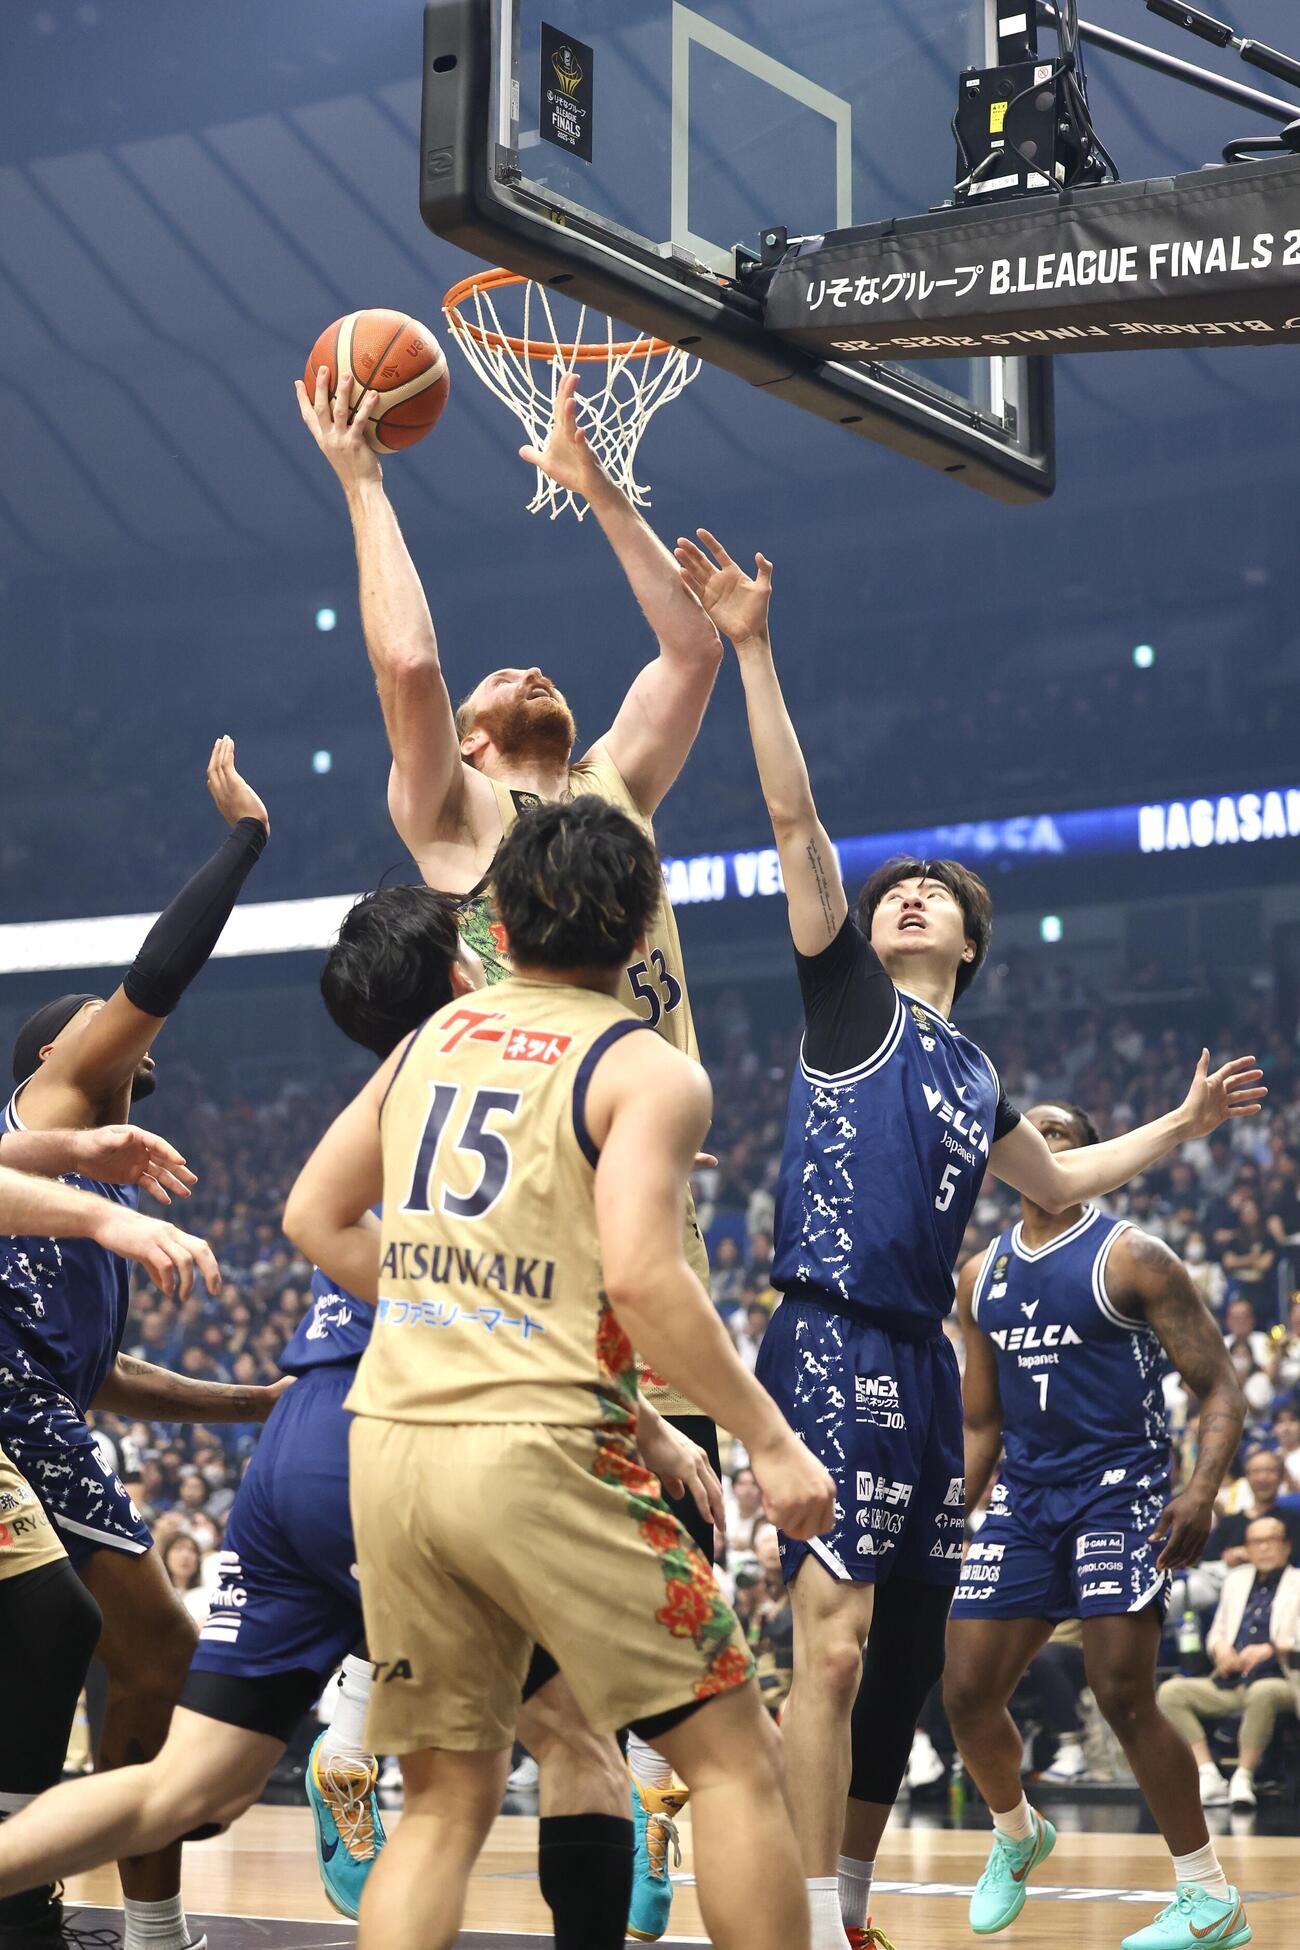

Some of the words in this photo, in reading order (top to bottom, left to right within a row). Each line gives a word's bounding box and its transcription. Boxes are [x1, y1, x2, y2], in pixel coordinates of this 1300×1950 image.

[552, 112, 581, 138] FINALS
[806, 264, 985, 311] りそなグループ
[989, 245, 1138, 295] B.LEAGUE
[1149, 232, 1275, 280] FINALS
[830, 335, 983, 352] 2025-26
[981, 325, 1111, 346] FINALS
[1108, 319, 1275, 335] B.LEAGUE
[626, 947, 683, 1028] 53
[438, 1008, 573, 1065] グーネット
[921, 1082, 990, 1159] VELCA
[401, 1080, 524, 1222] 15
[940, 1130, 976, 1168] Japanet
[934, 1163, 962, 1212] 5
[379, 1240, 557, 1300] ATSUWAKI
[989, 1324, 1084, 1351] VELCA
[1017, 1352, 1060, 1369] Japanet
[1032, 1372, 1050, 1412] 7
